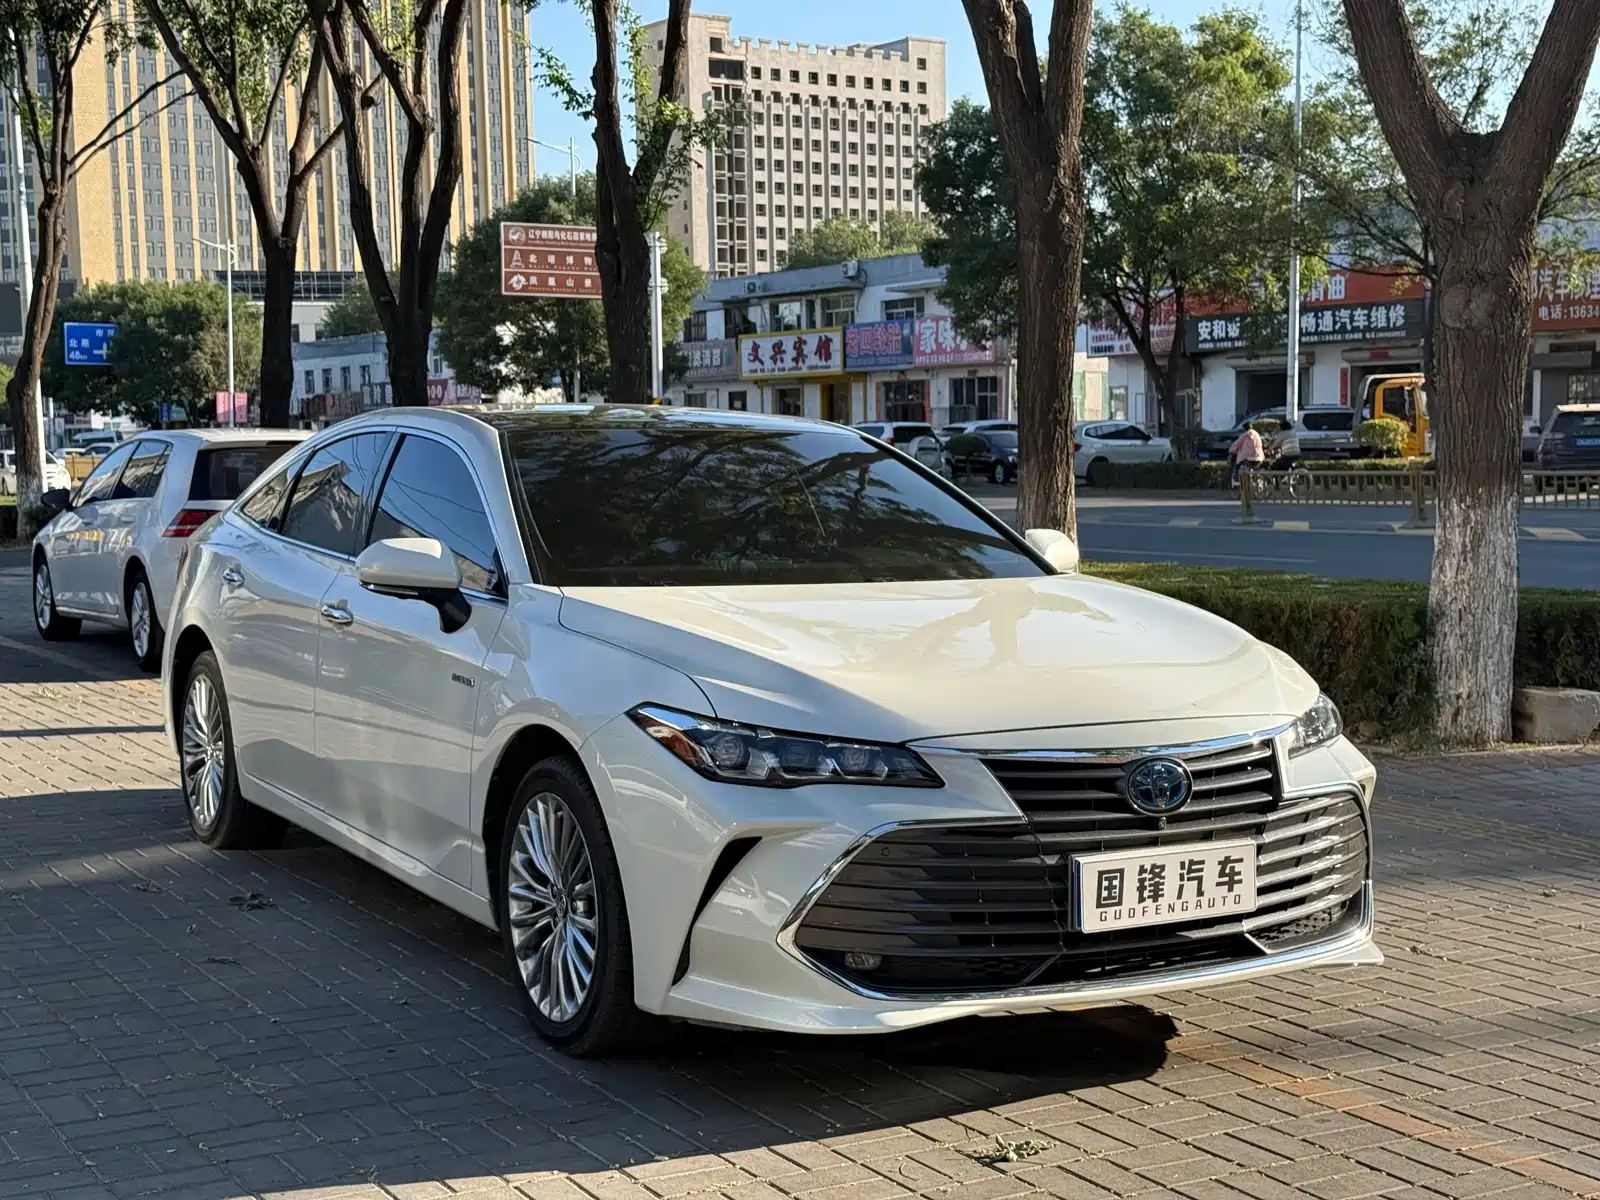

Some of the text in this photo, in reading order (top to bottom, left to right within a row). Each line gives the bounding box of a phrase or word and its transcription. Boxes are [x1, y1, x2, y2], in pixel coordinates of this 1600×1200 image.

[1301, 303, 1405, 333] 畅通汽车维修
[747, 334, 833, 367] 文兴宾馆
[1096, 855, 1244, 909] 国锋汽车
[1100, 894, 1241, 922] GUOFENGAUTO
